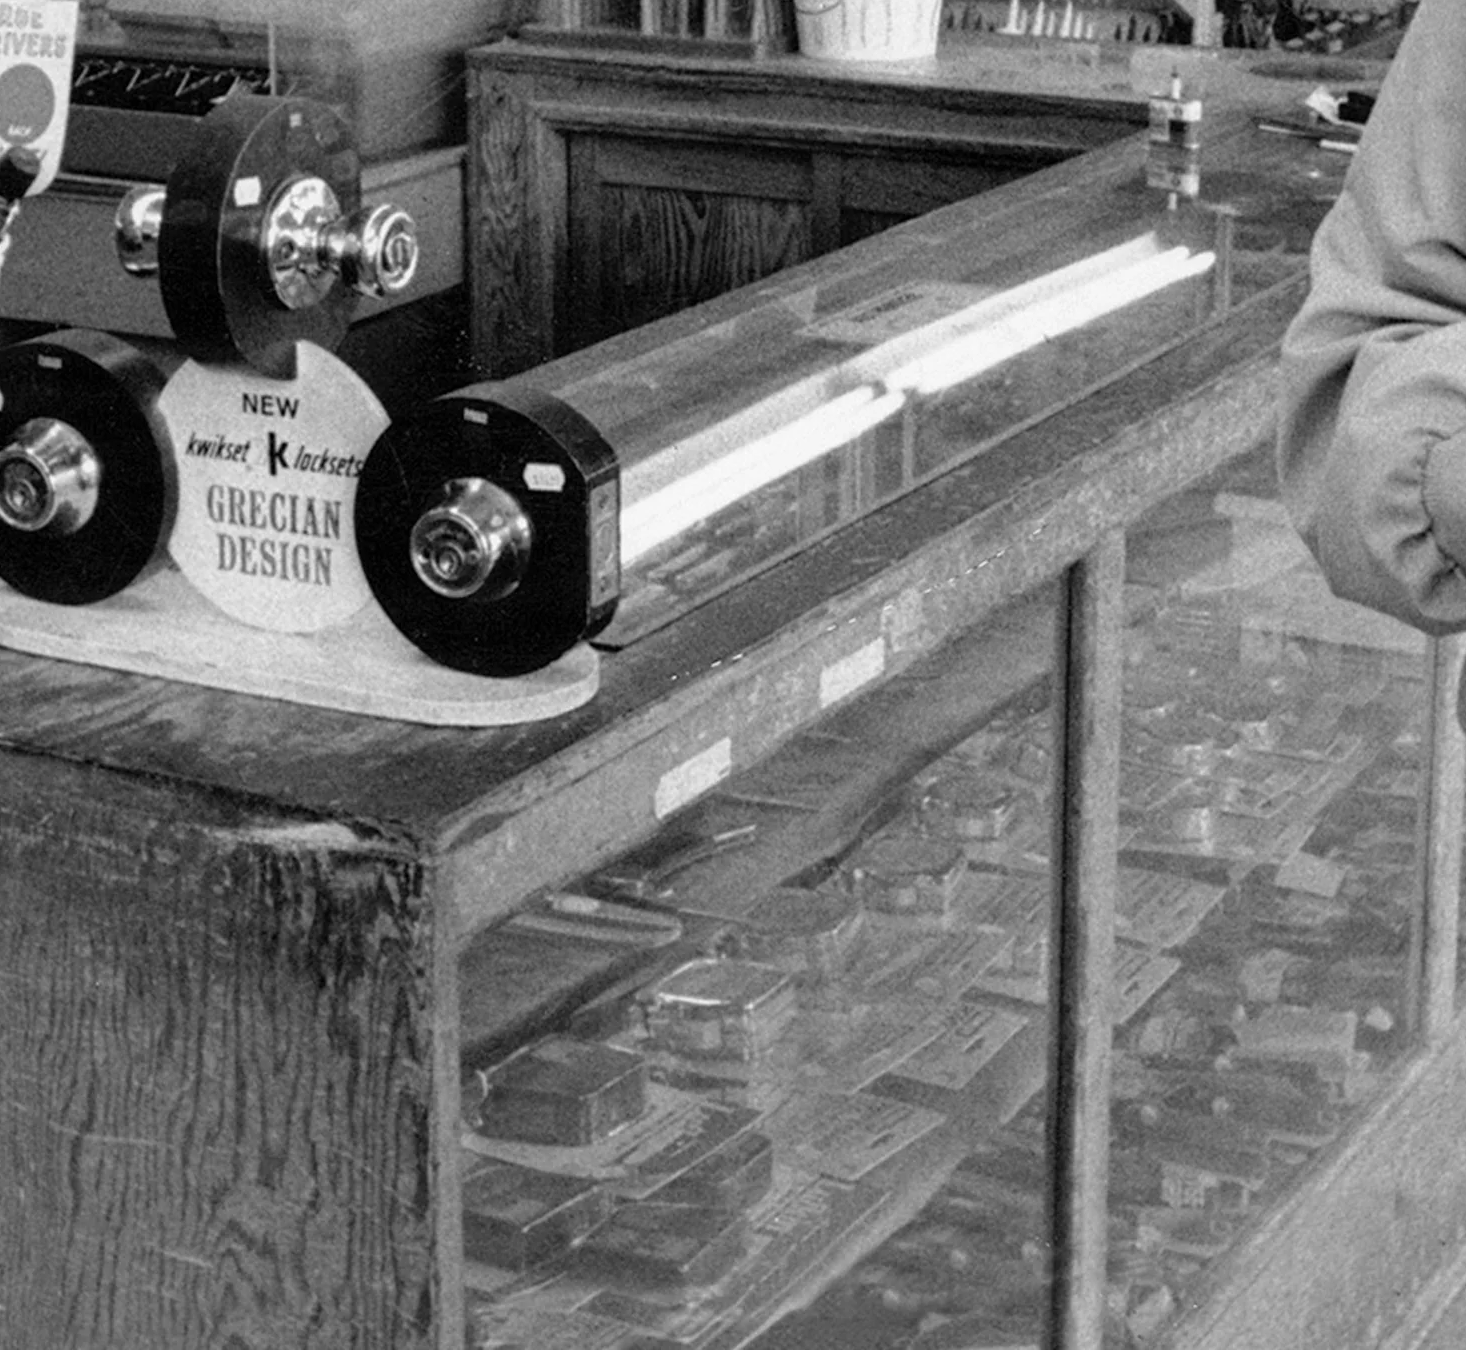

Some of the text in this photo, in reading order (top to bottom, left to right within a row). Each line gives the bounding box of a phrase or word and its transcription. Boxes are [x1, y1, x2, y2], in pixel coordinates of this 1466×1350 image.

[241, 392, 300, 419] NEW
[185, 431, 252, 463] kwikset
[293, 445, 364, 478] locksets
[206, 483, 342, 541] GRECIAN
[216, 532, 333, 587] DESIGN
